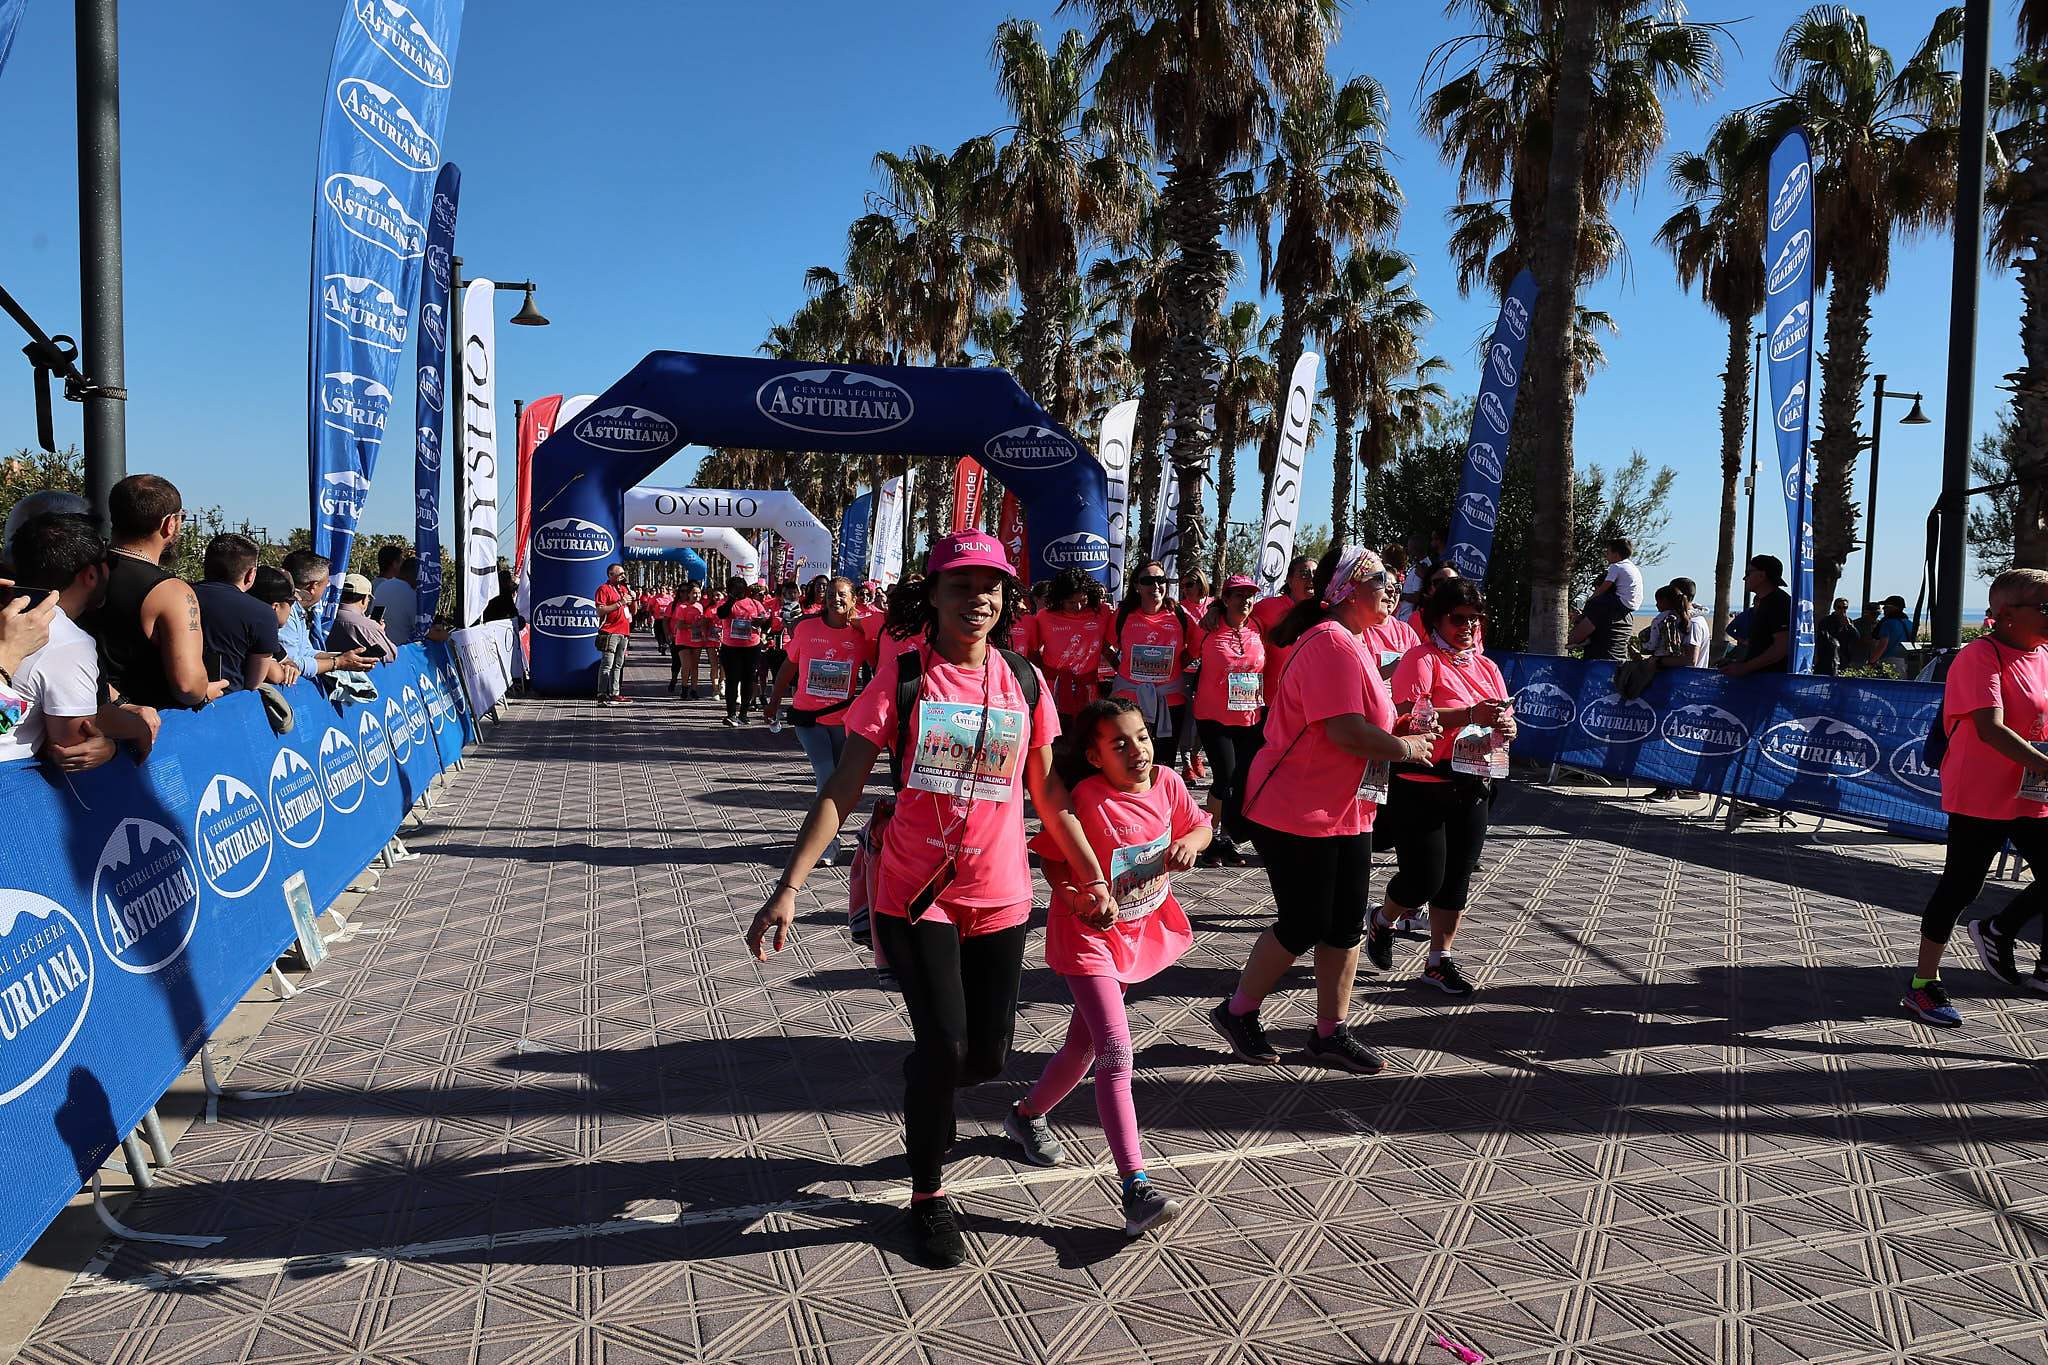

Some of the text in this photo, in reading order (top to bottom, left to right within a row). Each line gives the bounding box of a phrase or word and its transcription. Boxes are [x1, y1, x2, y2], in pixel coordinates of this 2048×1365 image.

[360, 1, 445, 85] ASTURIANA
[344, 87, 433, 167] ASTURIANA
[333, 183, 420, 252] ASTURIANA
[348, 189, 389, 216] CENTRAL
[769, 386, 902, 420] ASTURIANA
[794, 385, 897, 399] CENTRAL LECHERA
[580, 422, 670, 443] ASTURIANA
[993, 442, 1074, 459] ASTURIANA
[964, 470, 977, 530] antander
[1262, 385, 1307, 582] OYSHO
[655, 494, 758, 517] OYSHO
[538, 534, 609, 551] ASTURIANA
[955, 543, 991, 553] DRUNI
[1049, 549, 1108, 562] ASTURIAN
[536, 611, 600, 628] ASTURIAN
[1584, 708, 1648, 732] ASTURIANA
[1661, 716, 1742, 747] ASTURIANA
[1765, 735, 1867, 768] ASTURIANA
[323, 760, 363, 800] ASTURIANA
[918, 766, 942, 776] CARRERA
[983, 775, 1007, 785] VALENCIA
[974, 787, 1001, 796] antander
[210, 803, 259, 837] CENTRAL LECHERA
[275, 784, 321, 833] ASTURIANA
[203, 817, 269, 881] ASTURIANA
[115, 849, 182, 897] CENTRAL LECHERA
[105, 866, 196, 956] ASTURIANA
[13, 920, 66, 964] LECHERA
[0, 944, 88, 1041] URIANA
